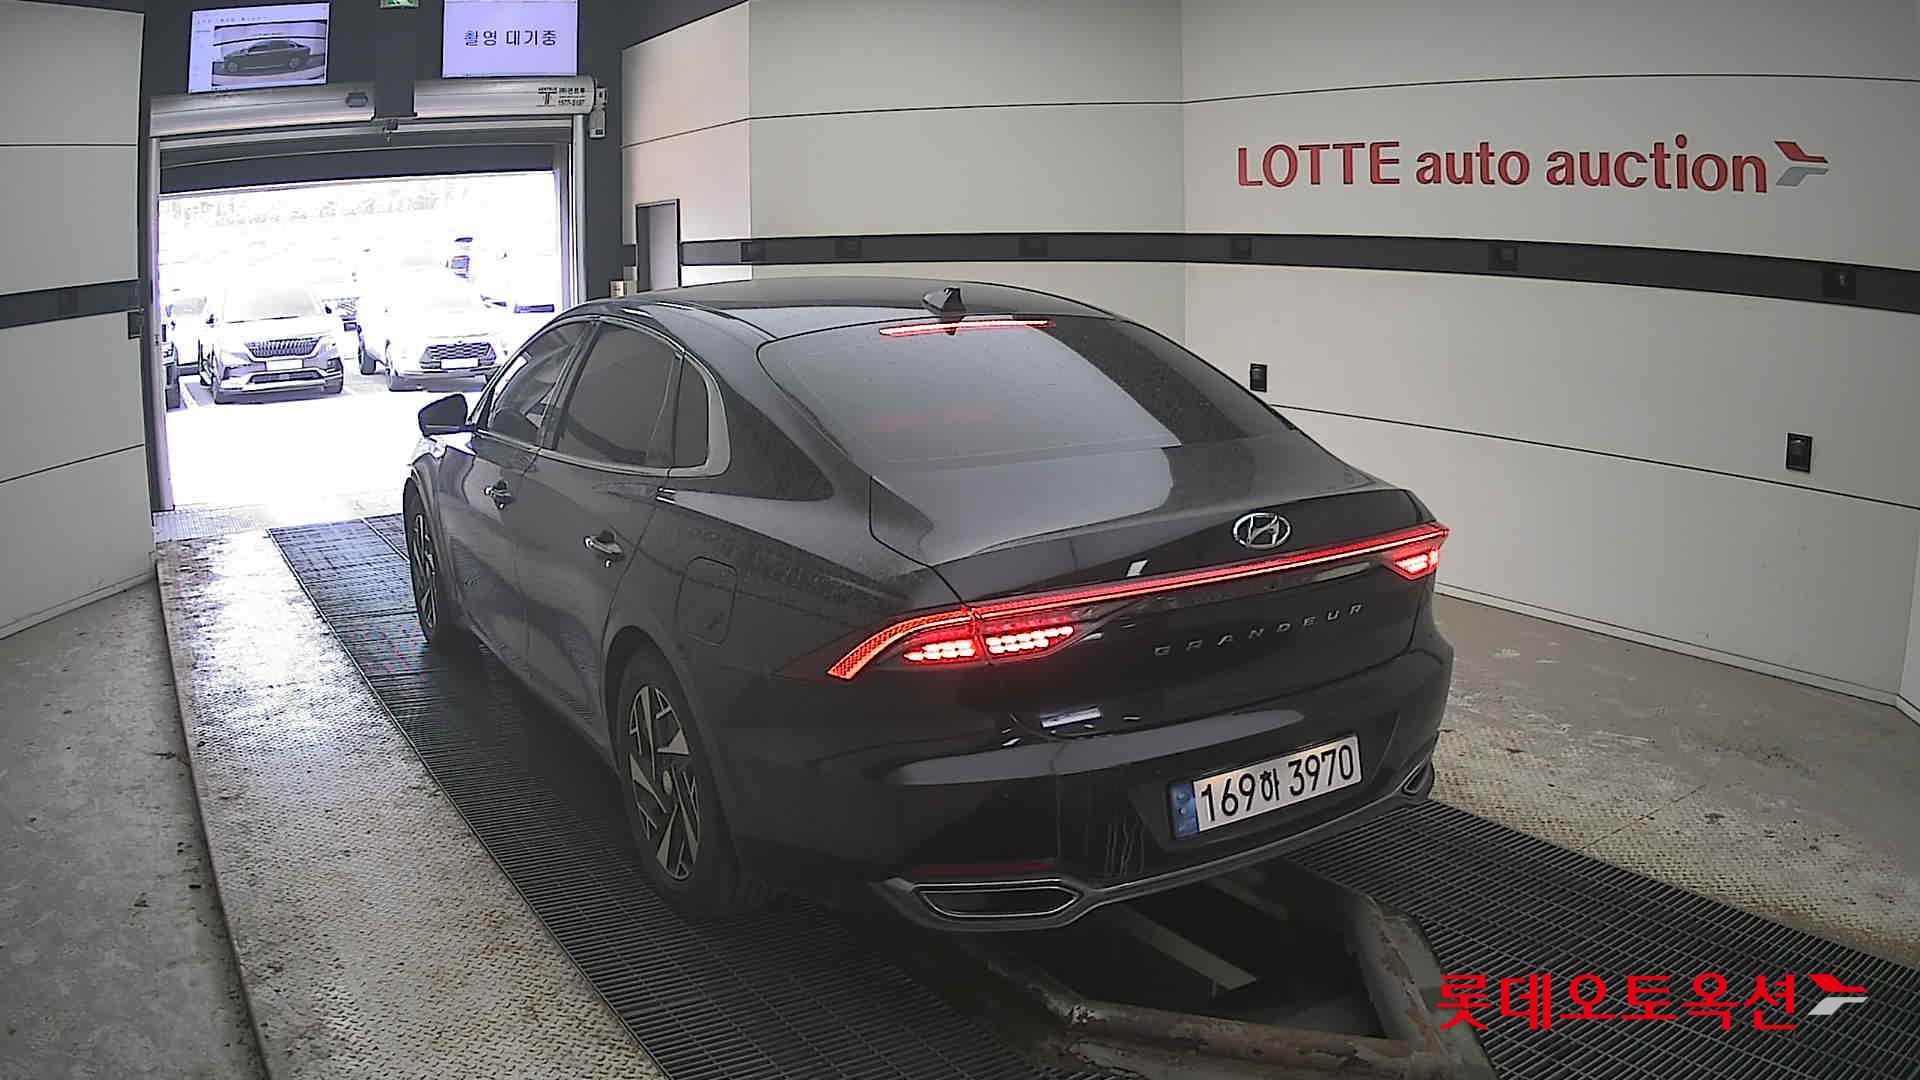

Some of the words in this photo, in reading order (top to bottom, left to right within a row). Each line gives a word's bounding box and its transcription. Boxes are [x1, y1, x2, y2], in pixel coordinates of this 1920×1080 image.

[506, 30, 557, 46] 대기중
[1238, 143, 1399, 187] LOTTE
[1417, 143, 1530, 186] auto
[1546, 135, 1766, 193] auction
[1154, 603, 1363, 657] GRANDEUR
[1201, 768, 1280, 822] 169하
[1288, 745, 1354, 796] 3970
